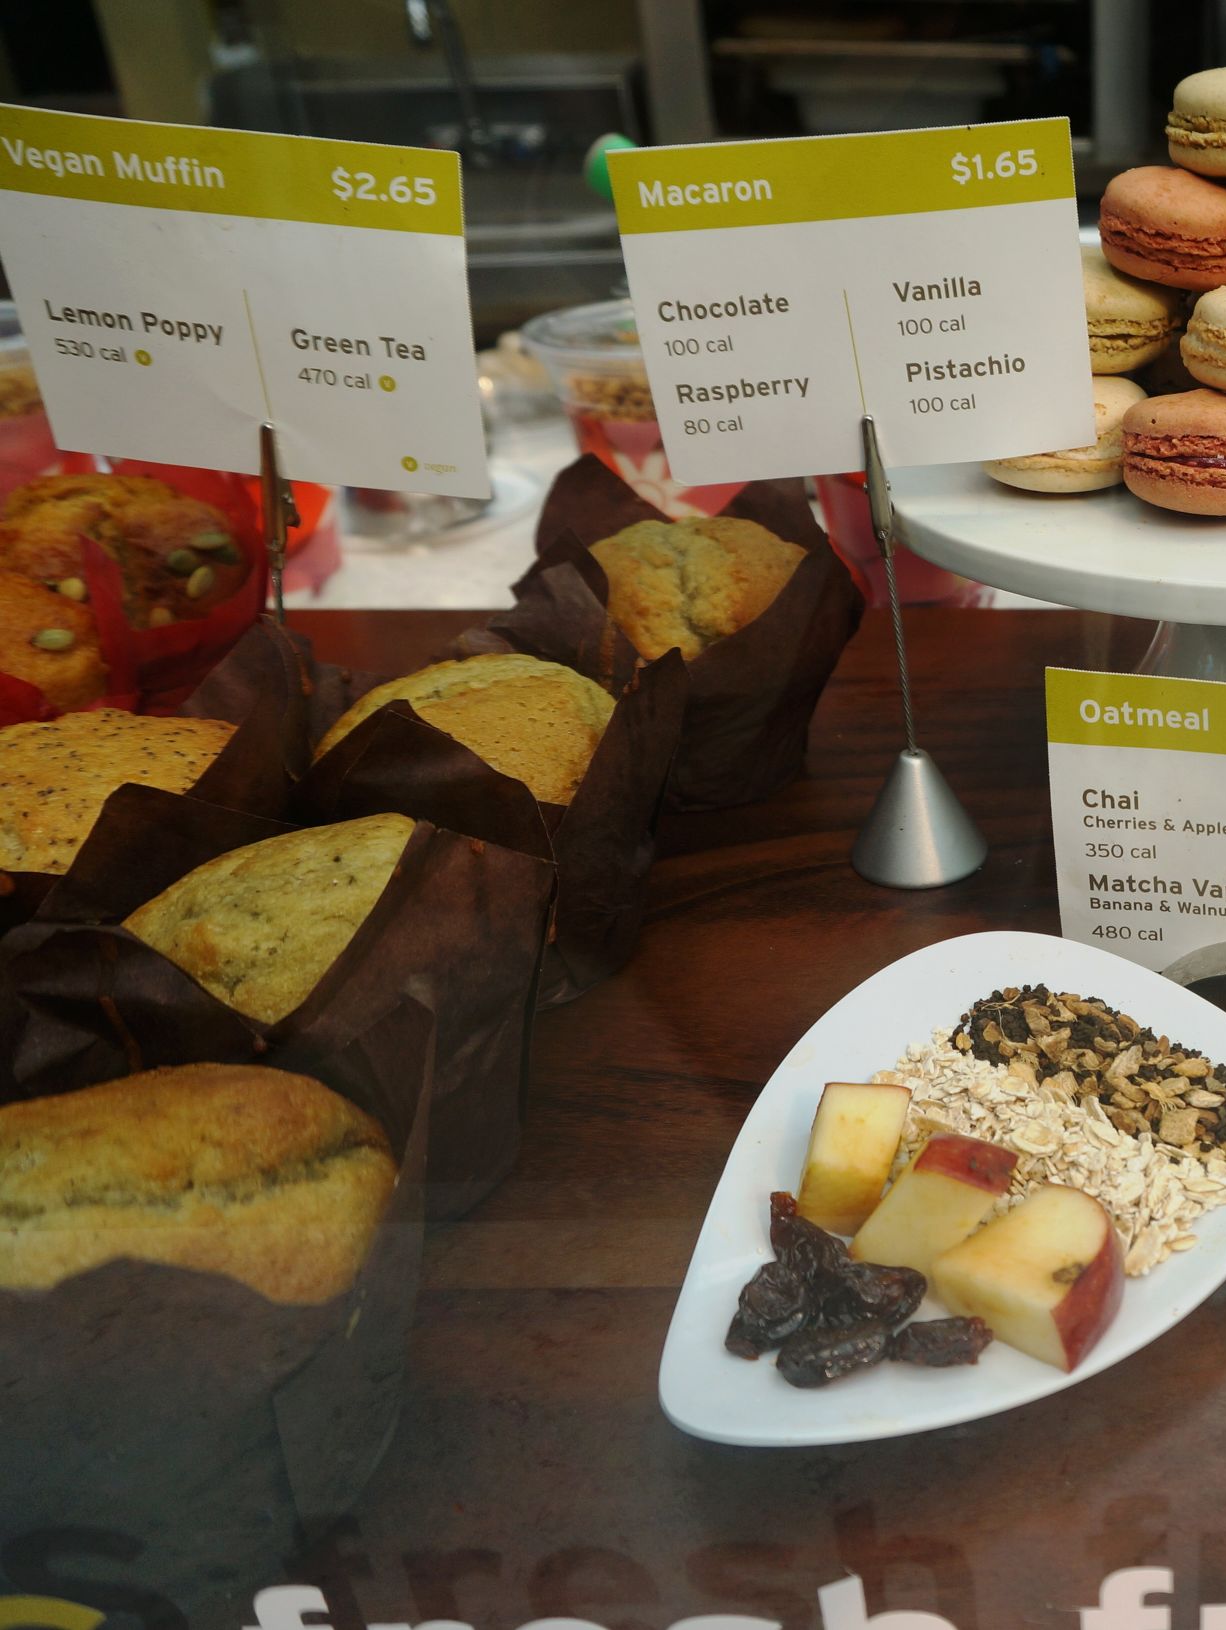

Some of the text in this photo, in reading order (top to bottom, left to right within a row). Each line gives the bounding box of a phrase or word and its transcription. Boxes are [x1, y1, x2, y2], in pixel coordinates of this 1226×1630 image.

[1, 136, 225, 188] Vegan Muffin
[950, 148, 1038, 185] $1.65
[331, 167, 436, 206] $2.65
[638, 175, 772, 208] Macaron
[893, 276, 982, 302] Vanilla
[658, 293, 789, 322] Chocolate
[43, 299, 223, 346] Lemon Poppy
[898, 315, 966, 336] 100 cal
[54, 338, 94, 358] 530
[99, 346, 128, 362] cal
[291, 328, 426, 361] Green Tea
[664, 336, 733, 357] 100 cal
[298, 368, 337, 386] 470
[343, 373, 371, 389] cal
[905, 354, 1026, 382] Pistachio
[676, 375, 810, 404] Raspberry
[909, 394, 976, 415] 100 cal
[684, 416, 743, 436] 80 cal
[1079, 698, 1210, 731] Oatmeal
[1082, 788, 1139, 811] Chai
[1083, 815, 1157, 831] Cherries
[1163, 819, 1176, 832] &
[1085, 843, 1157, 859] 350 cal
[1088, 873, 1183, 896] Matcha
[1090, 898, 1154, 912] Banana
[1159, 901, 1171, 912] &
[1091, 925, 1163, 942] 480 cal
